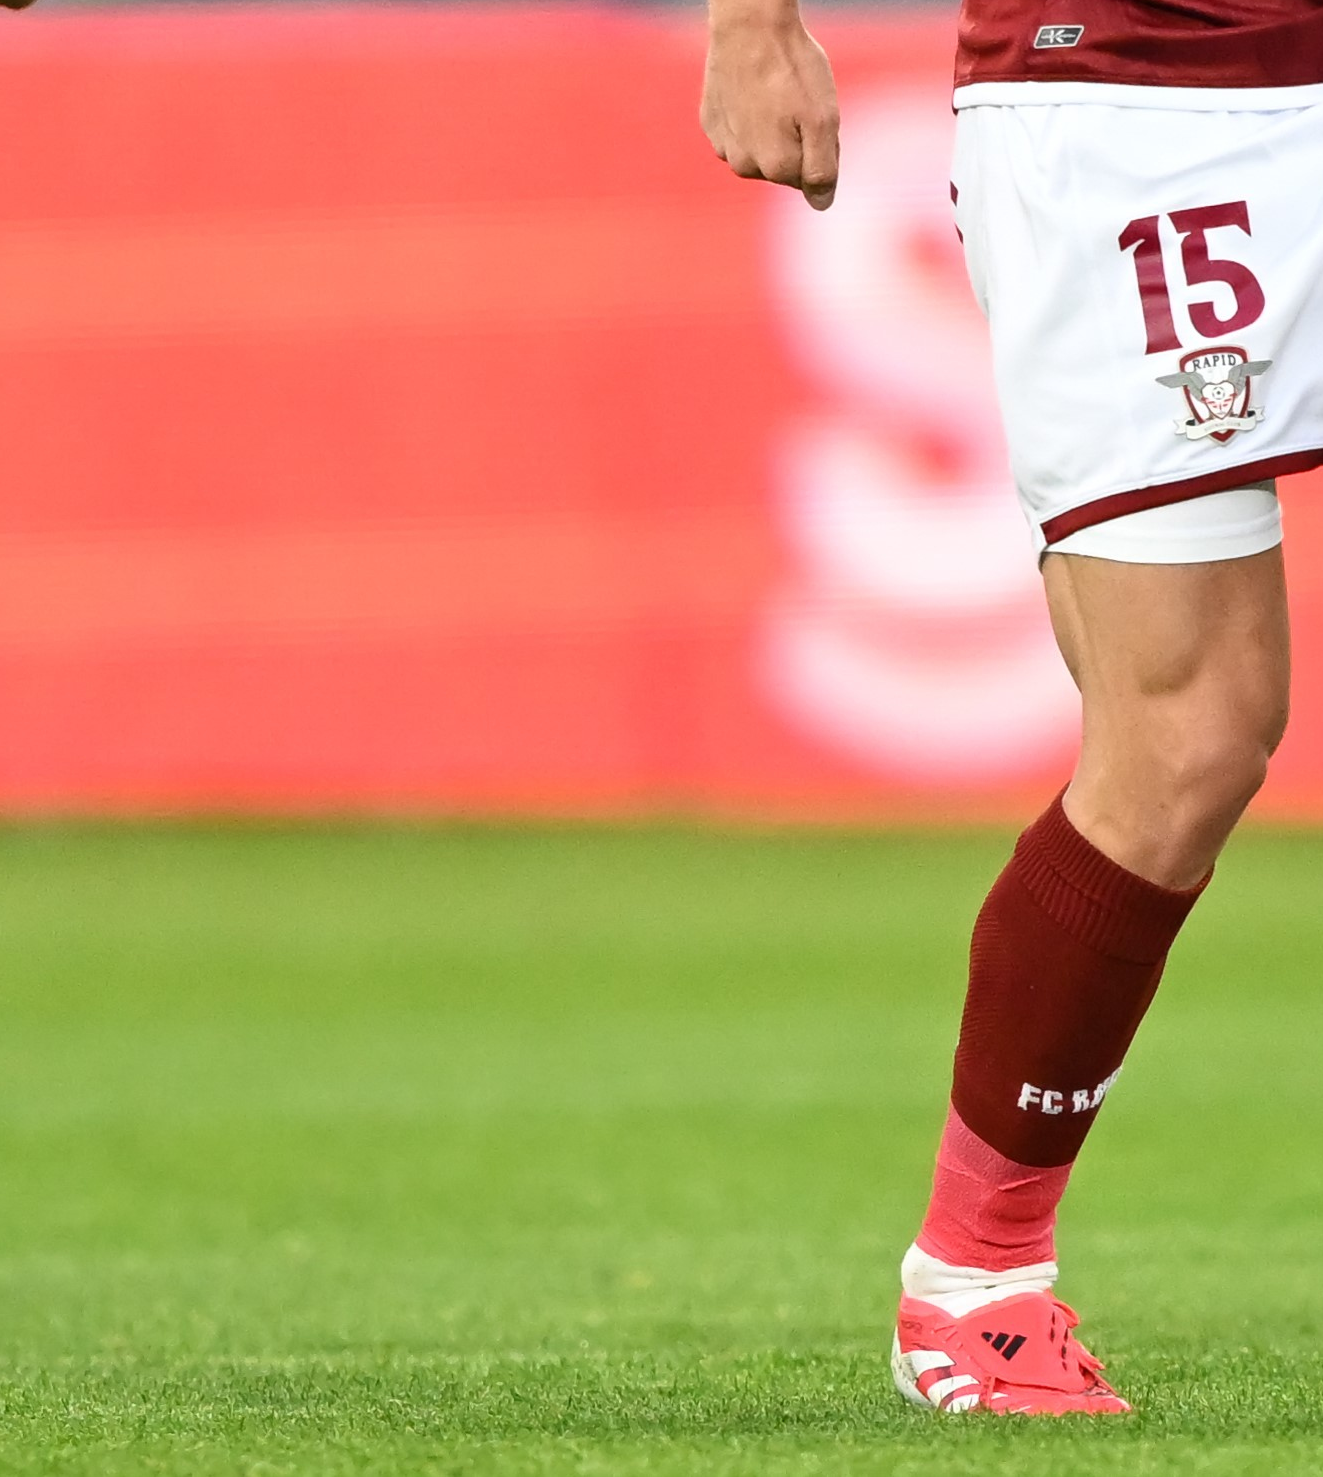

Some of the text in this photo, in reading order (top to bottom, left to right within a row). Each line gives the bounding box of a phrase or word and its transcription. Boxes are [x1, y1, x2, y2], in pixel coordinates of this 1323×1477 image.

[1118, 200, 1266, 355] 15
[1192, 354, 1236, 372] RAPID
[1017, 1082, 1063, 1114] FC
